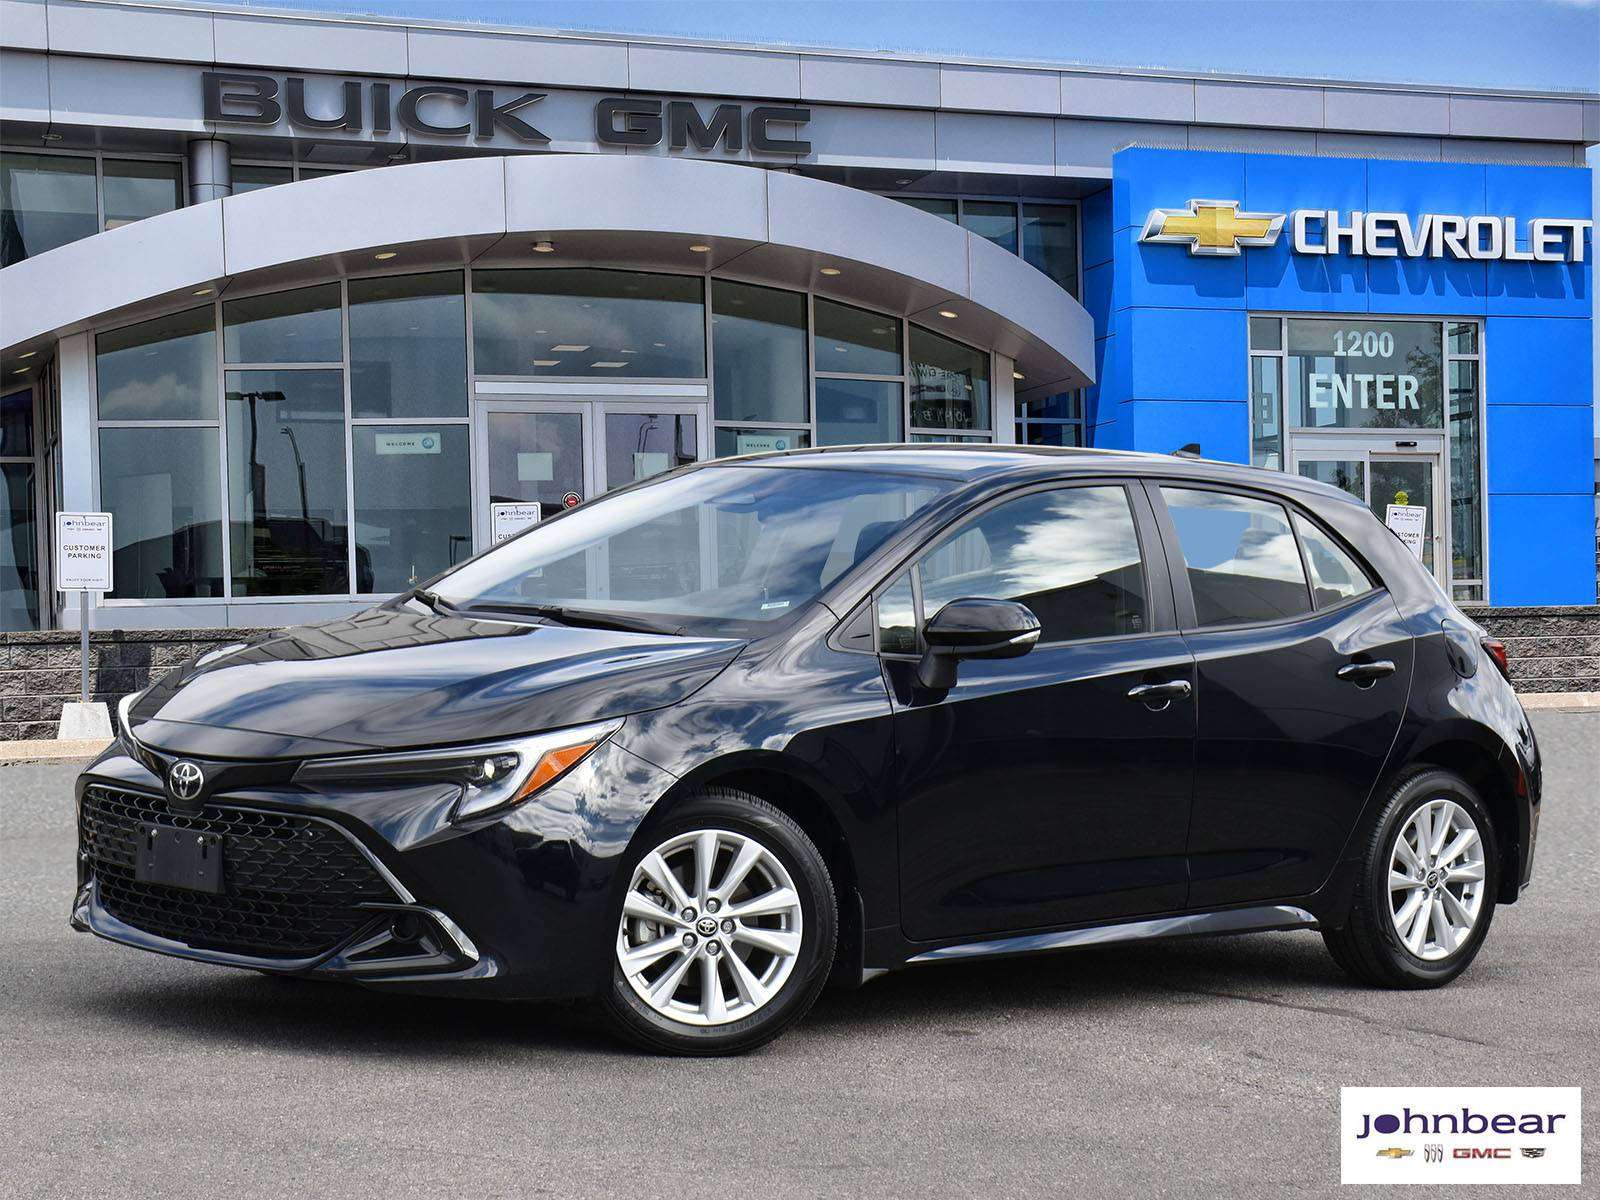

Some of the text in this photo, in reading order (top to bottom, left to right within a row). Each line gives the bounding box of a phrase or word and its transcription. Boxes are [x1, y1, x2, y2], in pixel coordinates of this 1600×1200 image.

[202, 71, 812, 156] BUICK GMC
[1293, 209, 1592, 263] CHEVROLET
[1333, 331, 1395, 358] 1200
[1308, 373, 1420, 411] ENTER
